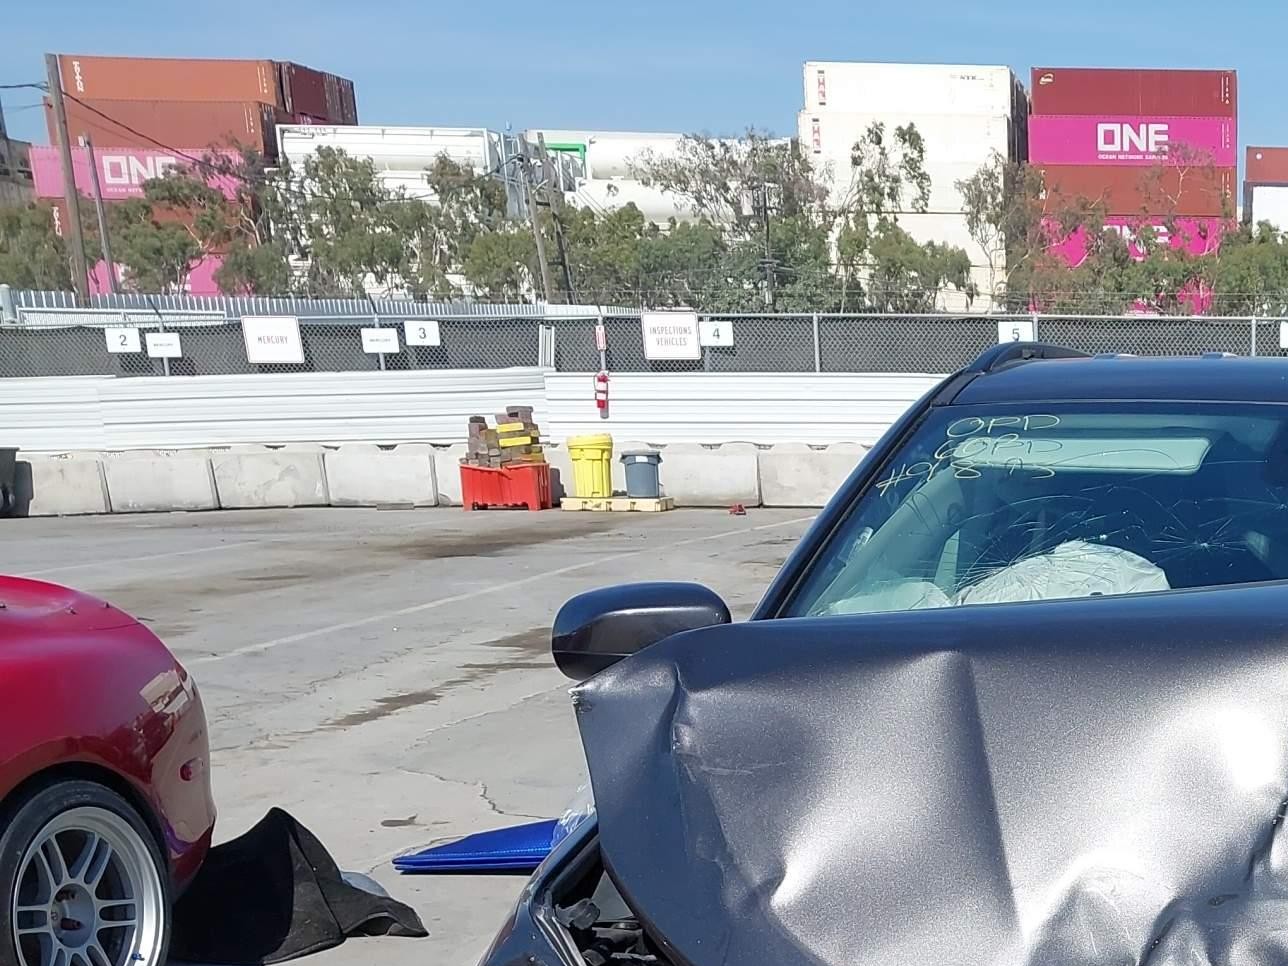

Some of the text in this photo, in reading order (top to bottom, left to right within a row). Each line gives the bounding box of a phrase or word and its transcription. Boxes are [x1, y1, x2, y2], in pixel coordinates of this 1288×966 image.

[1097, 123, 1169, 152] ONE
[418, 327, 427, 339] 3
[649, 326, 692, 335] INSPECTIONS
[712, 327, 721, 340] 4
[1011, 327, 1021, 342] 5
[118, 334, 128, 346] 2
[257, 335, 289, 345] MERCURY
[655, 337, 689, 346] VEHICLES
